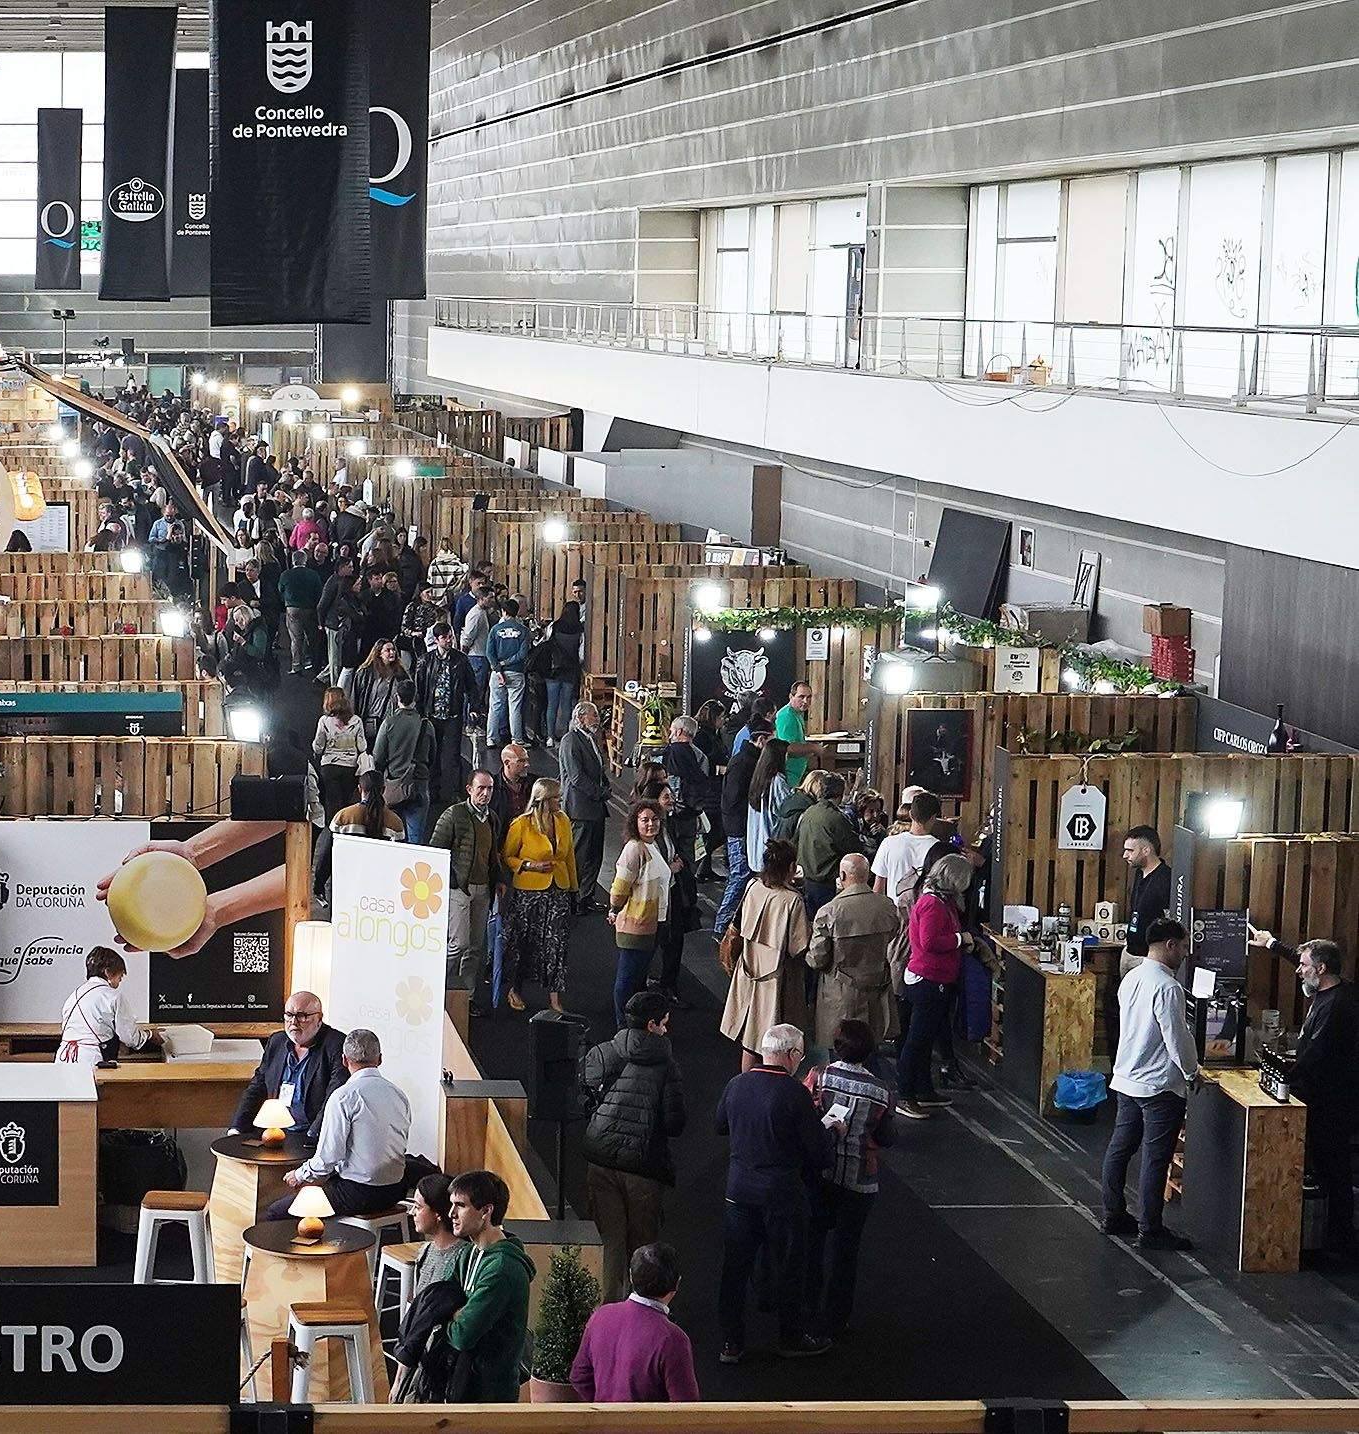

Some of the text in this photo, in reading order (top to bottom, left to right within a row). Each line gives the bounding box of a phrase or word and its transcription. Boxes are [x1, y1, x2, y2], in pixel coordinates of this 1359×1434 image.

[254, 104, 324, 120] Concello
[232, 122, 349, 139] de Pontevedra
[118, 190, 156, 202] Estrella
[118, 200, 154, 212] Galicia
[40, 200, 77, 250] Q
[16, 884, 86, 897] Deputación
[16, 895, 85, 908] DA CORUÑA
[359, 896, 395, 914] casa
[336, 906, 442, 957] alongos
[13, 943, 84, 957] a provincia
[24, 954, 54, 966] sabe
[1, 1171, 40, 1184] CORUÑA
